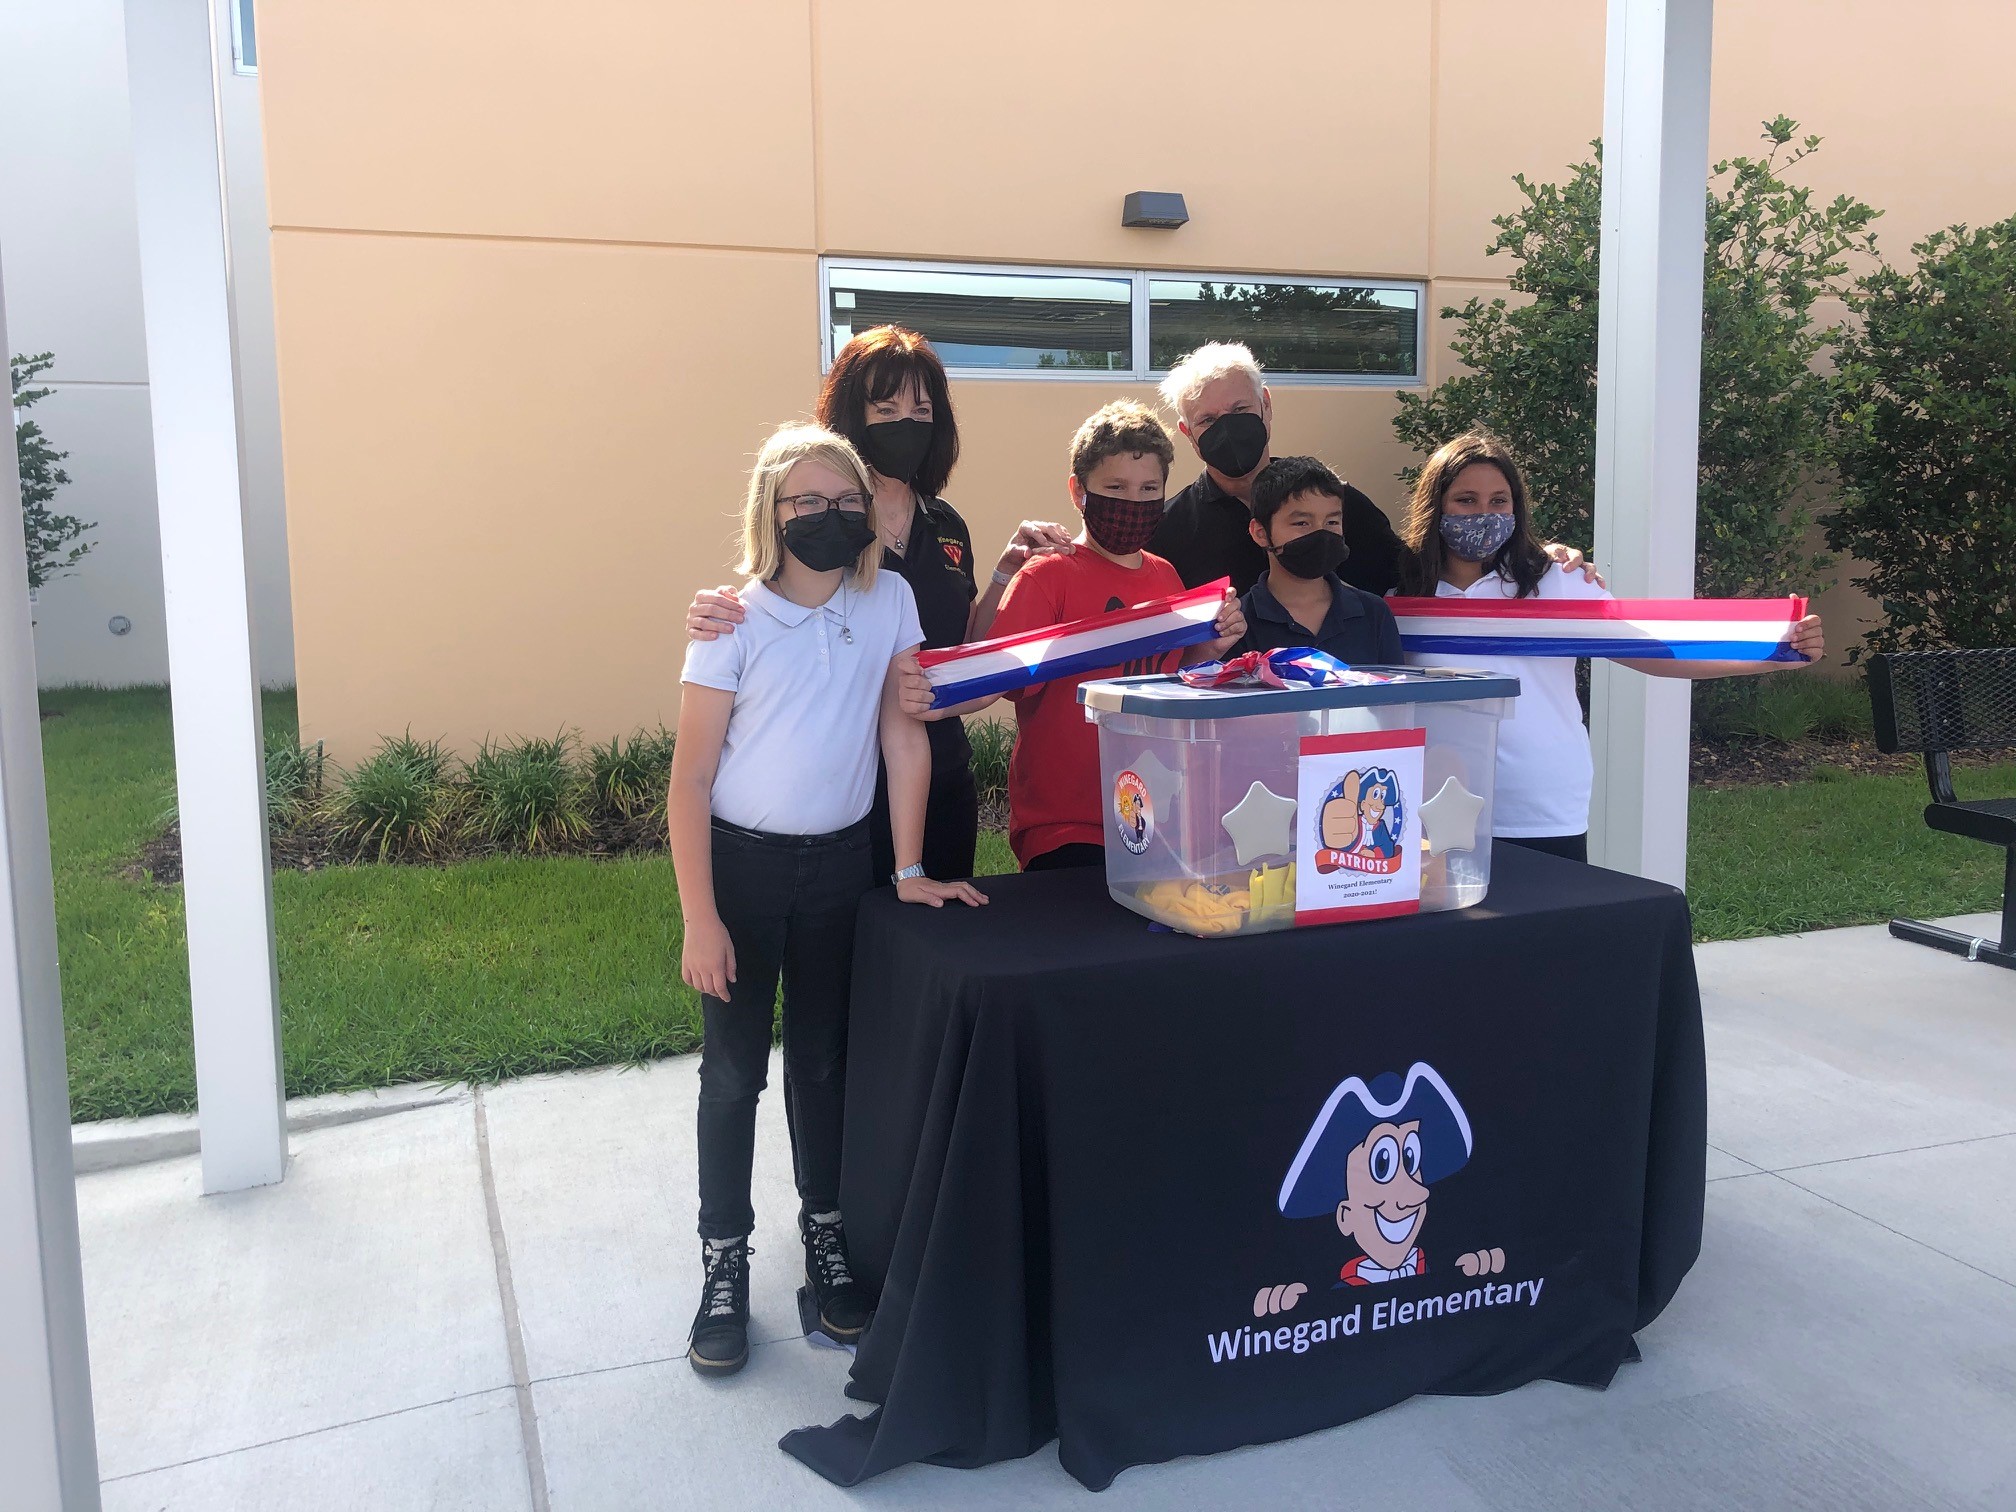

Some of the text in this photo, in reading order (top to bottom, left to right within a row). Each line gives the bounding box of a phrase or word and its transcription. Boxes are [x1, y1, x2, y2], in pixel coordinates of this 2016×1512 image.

[1118, 774, 1147, 797] WINEGARD
[1118, 824, 1150, 854] ELEMENTARY
[1330, 851, 1388, 872] PATRIOTS
[1328, 878, 1392, 890] Winegard Elementary
[1207, 1277, 1545, 1363] Winegard Elementary
